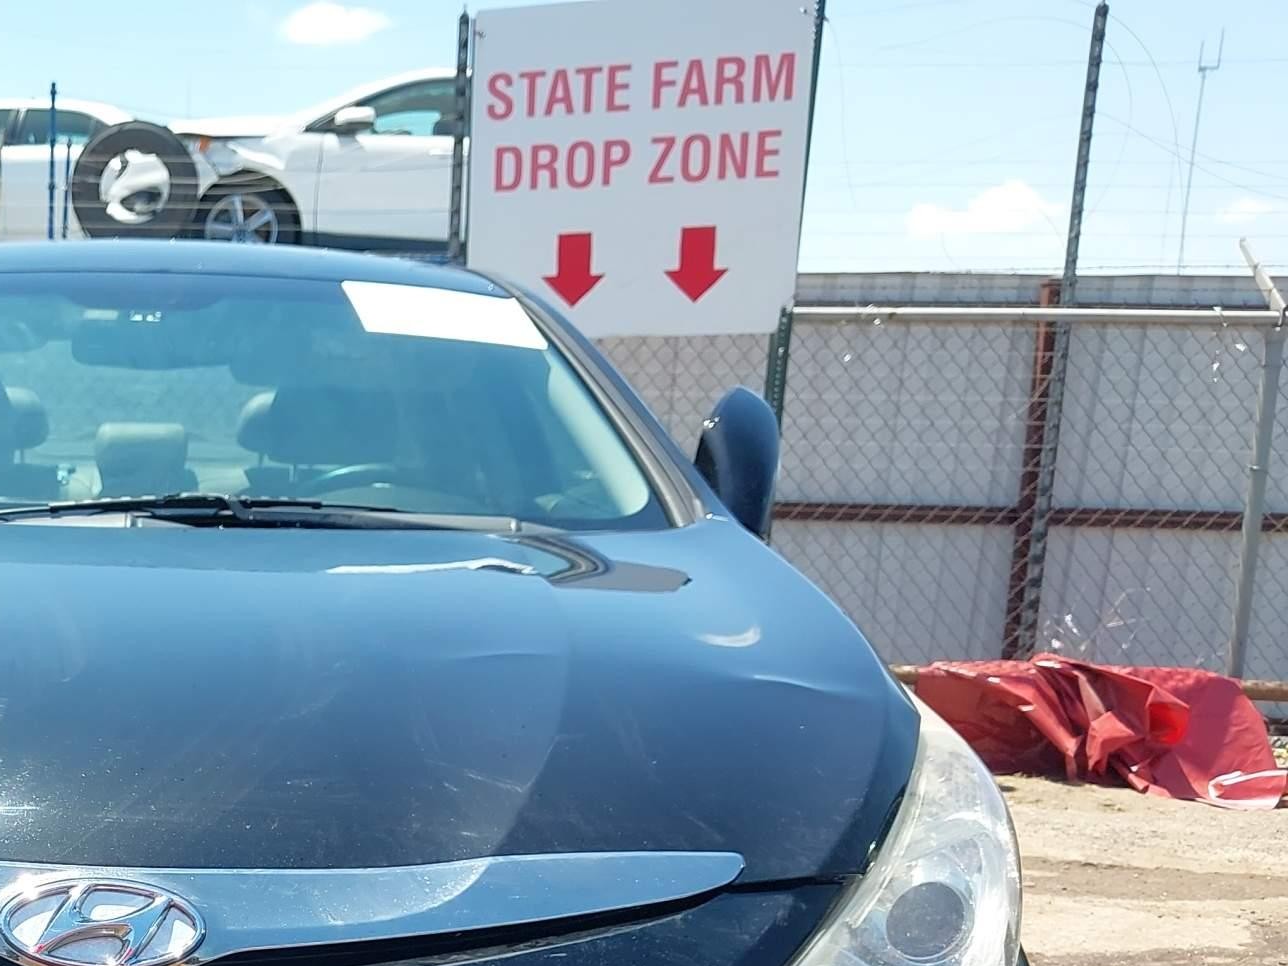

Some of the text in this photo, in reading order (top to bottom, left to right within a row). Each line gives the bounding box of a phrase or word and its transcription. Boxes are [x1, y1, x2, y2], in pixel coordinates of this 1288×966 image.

[486, 51, 797, 121] STATE FARM
[493, 129, 782, 193] DROP ZONE
